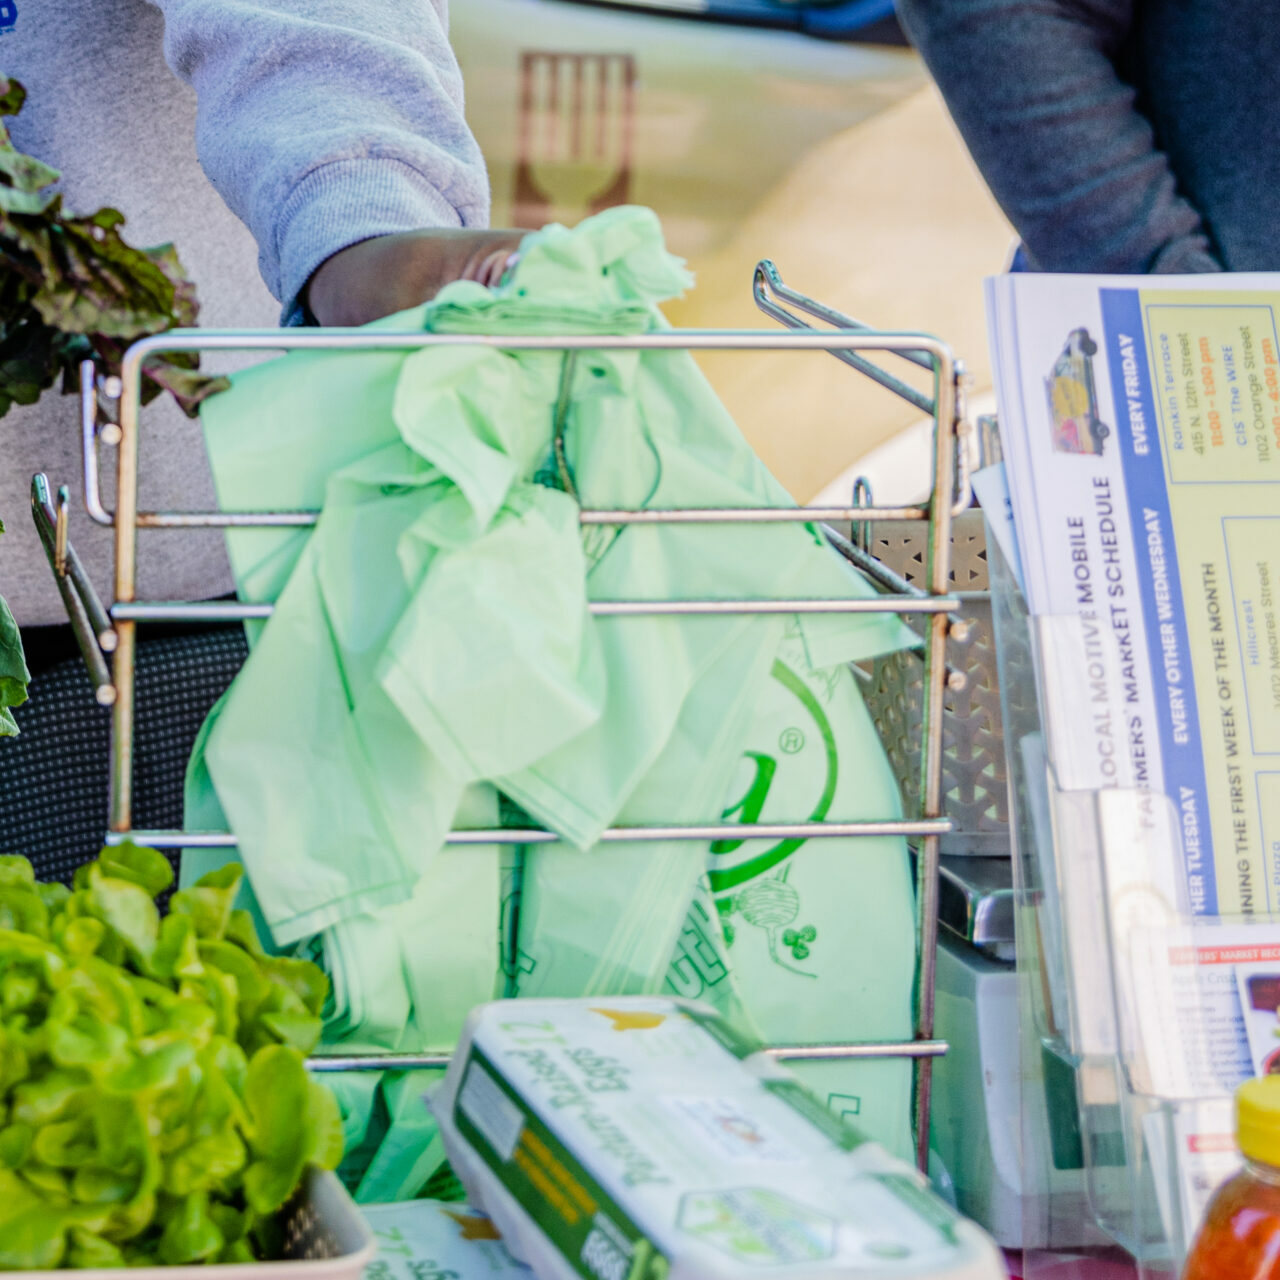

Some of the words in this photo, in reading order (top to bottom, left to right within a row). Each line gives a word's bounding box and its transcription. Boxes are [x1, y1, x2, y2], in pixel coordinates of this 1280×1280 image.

[1118, 334, 1140, 397] FRIDAY
[1159, 332, 1177, 392] Terrace
[1176, 332, 1194, 377] Street
[1197, 336, 1216, 364] pm
[1220, 344, 1237, 383] WIRE
[1238, 325, 1256, 370] Street
[1127, 401, 1150, 457] EVERY
[1167, 395, 1185, 451] Rankin
[1229, 387, 1243, 415] The
[1247, 373, 1265, 431] Orange
[1068, 517, 1093, 604] MOBILE
[1093, 476, 1124, 597] SCHEDULE
[1142, 506, 1175, 622] WEDNESDAY
[1200, 562, 1223, 633] MONTH
[1256, 561, 1273, 607] Street
[1079, 610, 1109, 703] MOTIVE
[1109, 604, 1139, 703] MARKET
[1159, 622, 1182, 683] OTHER
[1210, 637, 1229, 672] THE
[1242, 599, 1261, 666] Hillcrest
[1168, 685, 1190, 745] EVERY
[1216, 675, 1233, 701] OF
[1094, 709, 1118, 789] LOCAL
[1220, 704, 1239, 758] WEEK
[1226, 763, 1245, 814] FIRST
[1179, 787, 1202, 872] TUESDAY
[1232, 818, 1250, 854] THE
